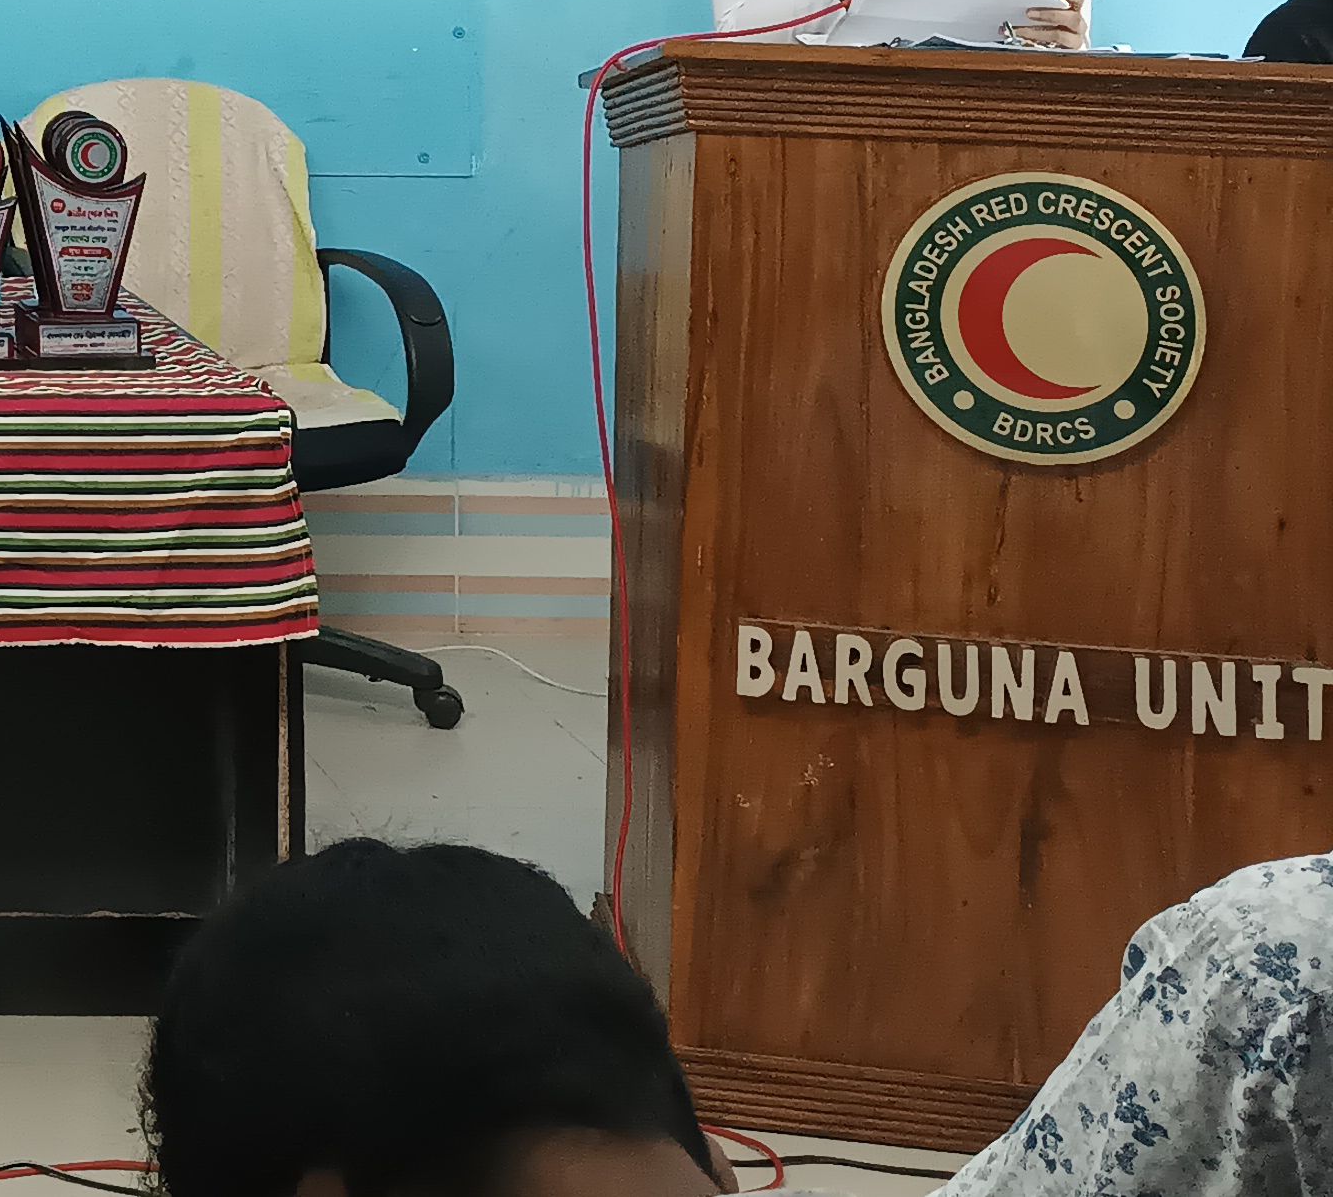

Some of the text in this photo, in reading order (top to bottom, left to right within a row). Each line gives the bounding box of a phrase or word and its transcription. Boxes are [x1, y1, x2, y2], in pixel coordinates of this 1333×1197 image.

[904, 191, 1186, 400] BANGLADESH RED CRESCENT SOCIETY
[991, 410, 1097, 447] BDRCS
[735, 623, 1333, 742] BARGUNA UNIT
